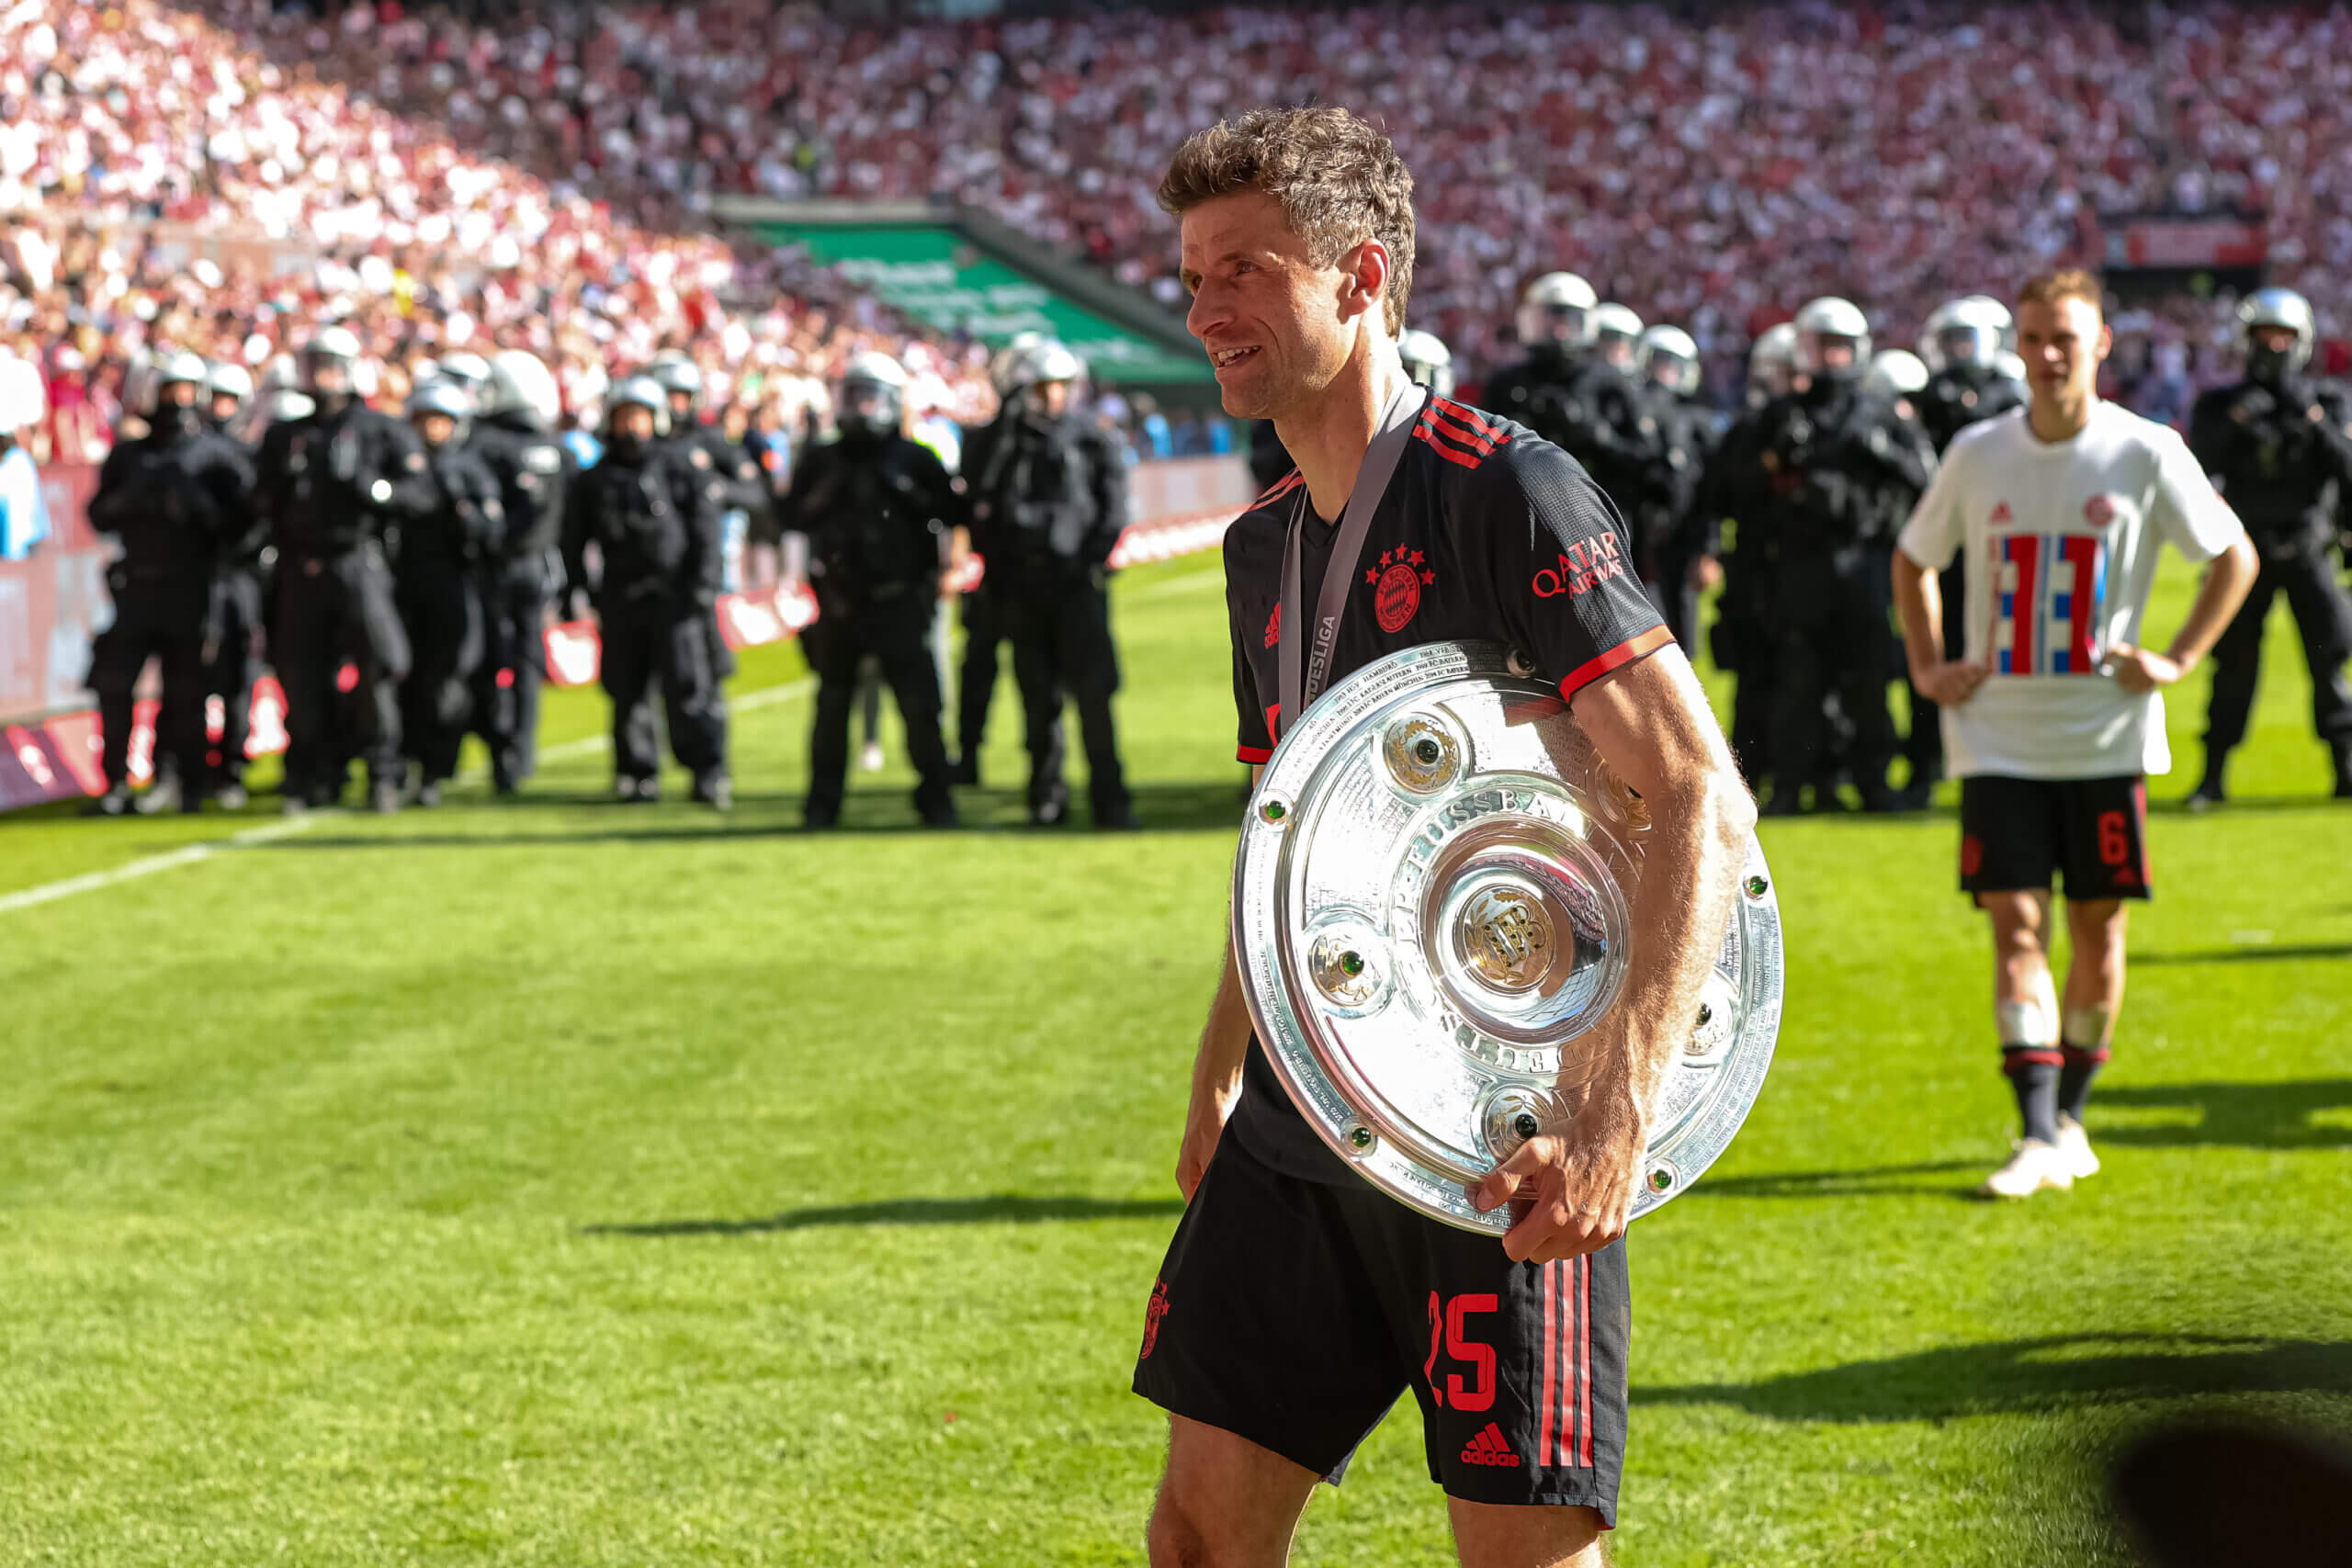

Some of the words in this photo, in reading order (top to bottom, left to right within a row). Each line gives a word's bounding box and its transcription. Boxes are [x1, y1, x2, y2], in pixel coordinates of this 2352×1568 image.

[1532, 532, 1620, 598] QATAR
[2098, 811, 2129, 865] 6
[1460, 1450, 1521, 1467] adidas
